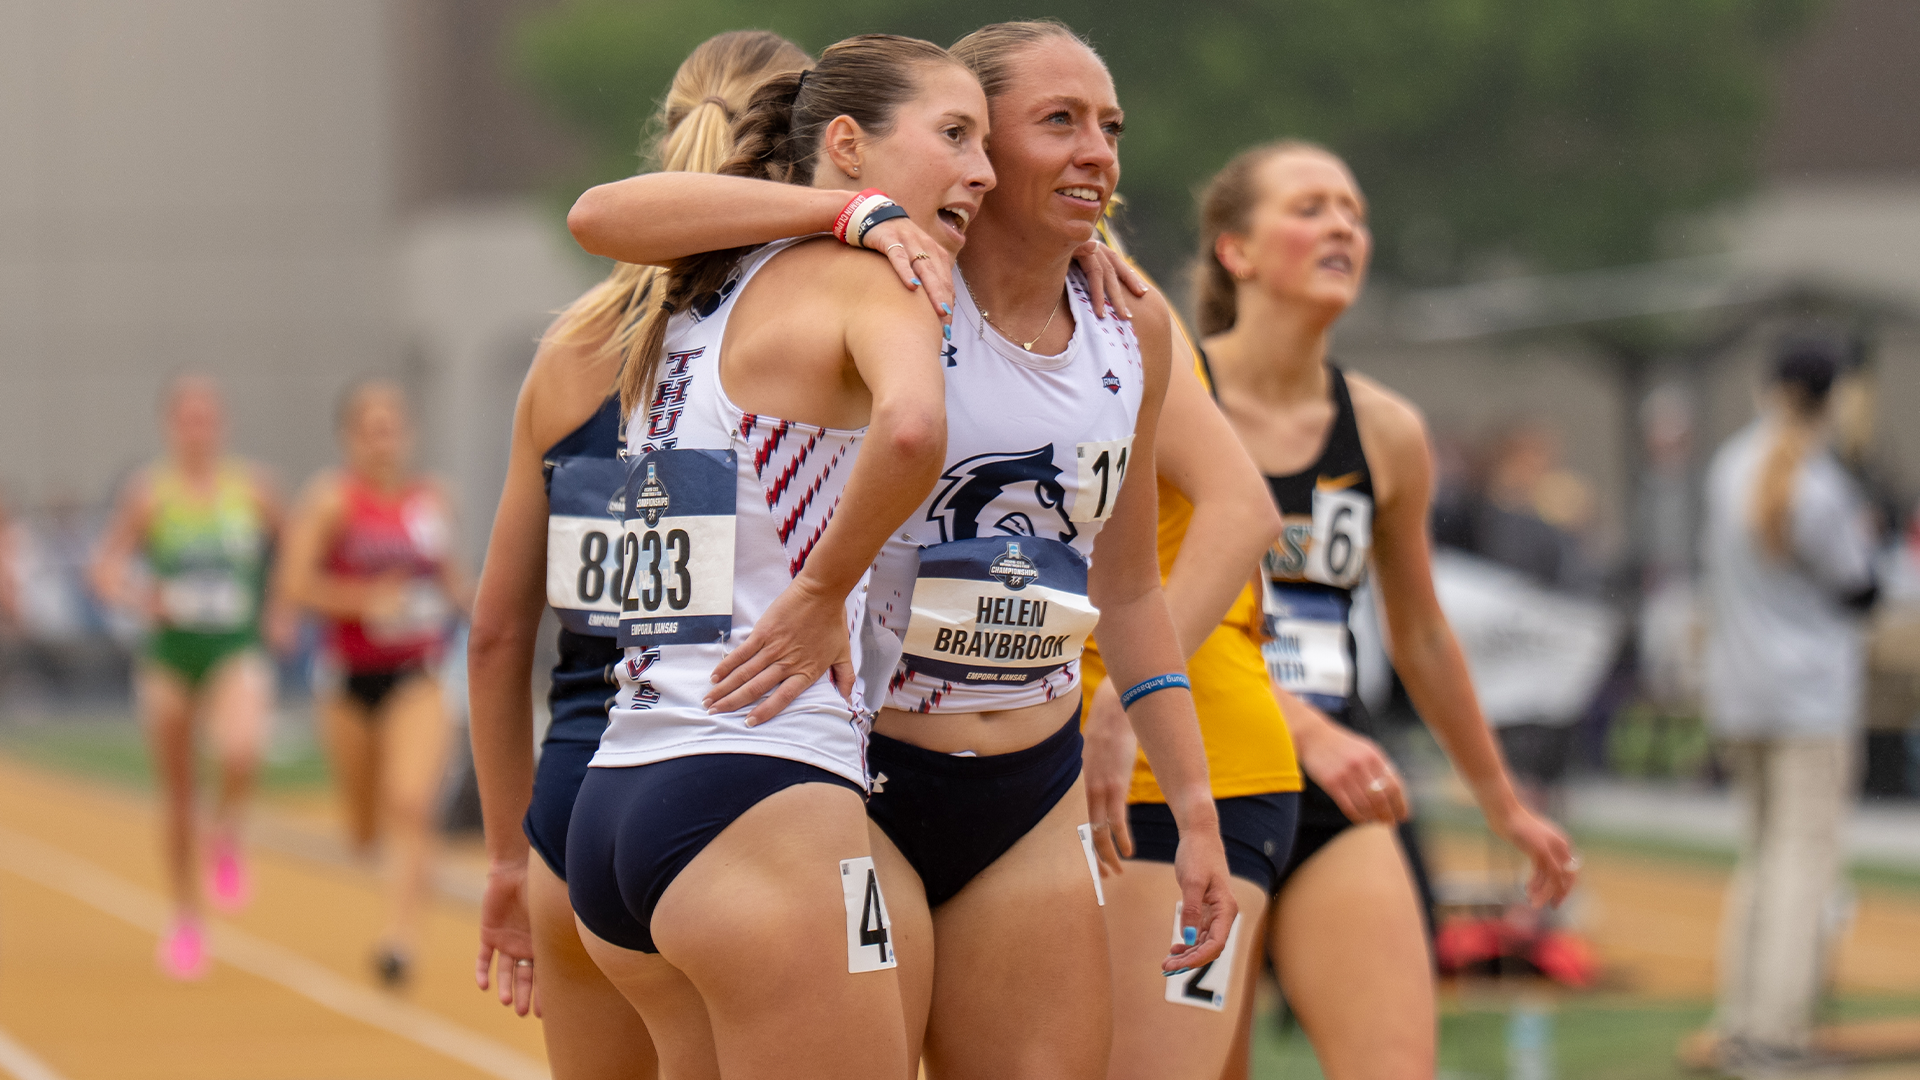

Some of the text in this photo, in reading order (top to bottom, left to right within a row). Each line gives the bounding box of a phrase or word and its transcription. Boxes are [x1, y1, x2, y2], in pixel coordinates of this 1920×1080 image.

[1326, 505, 1353, 577] 6
[622, 528, 691, 612] 233
[990, 566, 1038, 578] CHAMPIONSHIPS
[975, 596, 1048, 627] HELEN
[653, 622, 678, 634] KANSAS
[933, 627, 1071, 660] BRAYBROOK
[999, 673, 1028, 682] KANSAS
[859, 868, 888, 964] 4
